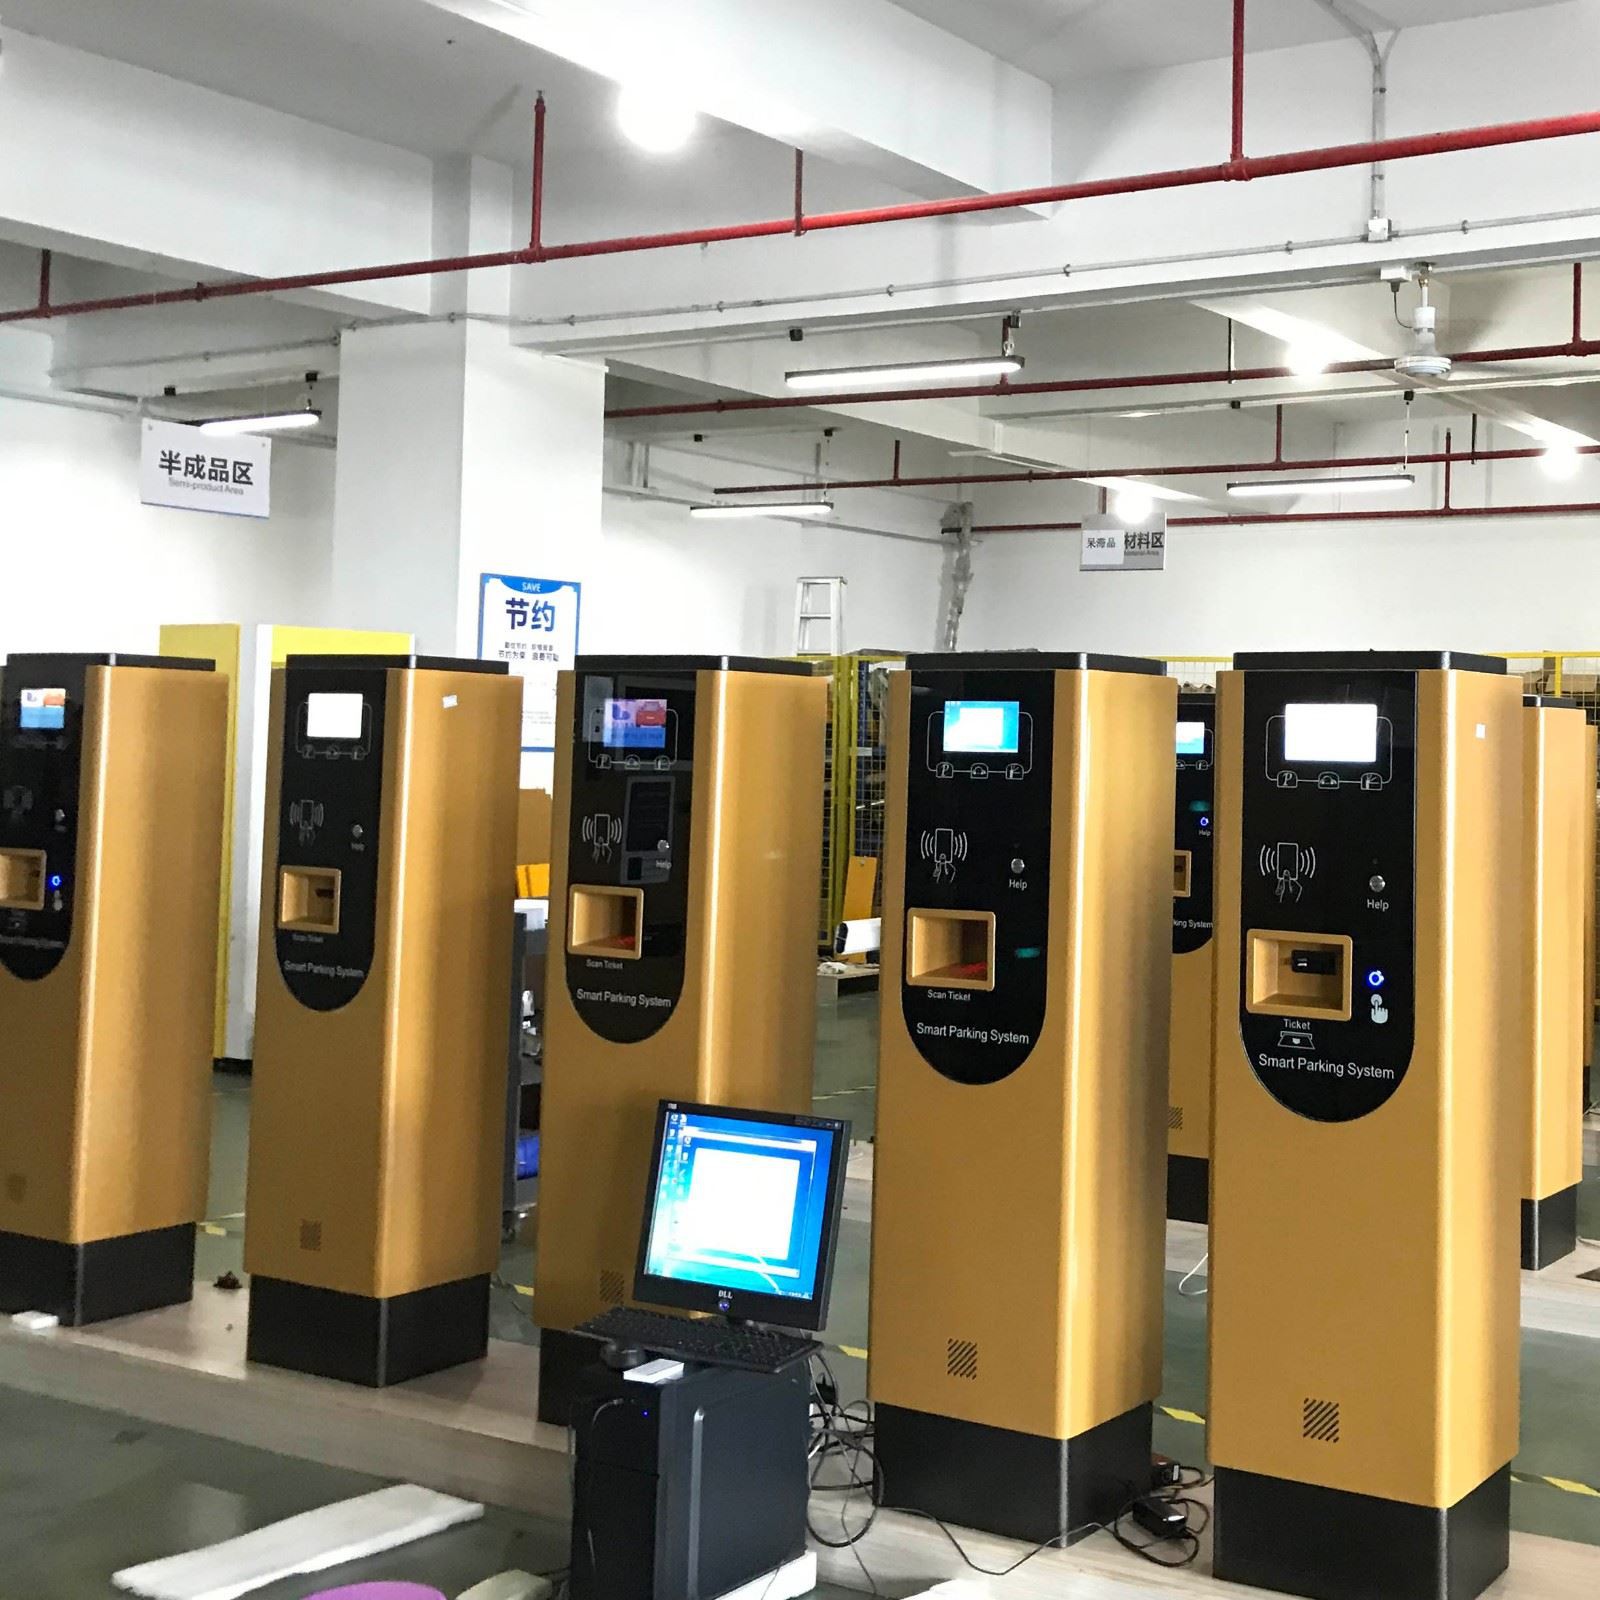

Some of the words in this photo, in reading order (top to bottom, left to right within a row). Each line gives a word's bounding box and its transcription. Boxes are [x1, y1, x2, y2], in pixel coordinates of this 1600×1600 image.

[158, 449, 254, 486] 半成品区
[225, 484, 244, 496] Area
[1124, 531, 1164, 550] 材料区
[522, 581, 541, 593] SAVE
[505, 597, 556, 632] 节约
[1008, 879, 1028, 891] Help
[1366, 899, 1389, 912] Help
[1173, 919, 1187, 929] king
[1188, 919, 1213, 929] System
[284, 960, 306, 973] Smart
[308, 962, 335, 978] Parking
[336, 965, 364, 979] System
[586, 958, 603, 969] Scan
[604, 960, 623, 970] Ticket
[577, 988, 602, 1001] Smart
[604, 990, 637, 1007] Parking
[638, 993, 672, 1008] System
[927, 989, 947, 999] Scan
[948, 990, 971, 1001] Ticket
[1283, 1018, 1311, 1030] Ticket
[916, 1022, 947, 1037] Smart
[949, 1025, 988, 1043] Parking
[990, 1028, 1029, 1045] System
[1258, 1053, 1295, 1069] Smart
[1297, 1057, 1344, 1078] Parking
[1347, 1062, 1395, 1080] System
